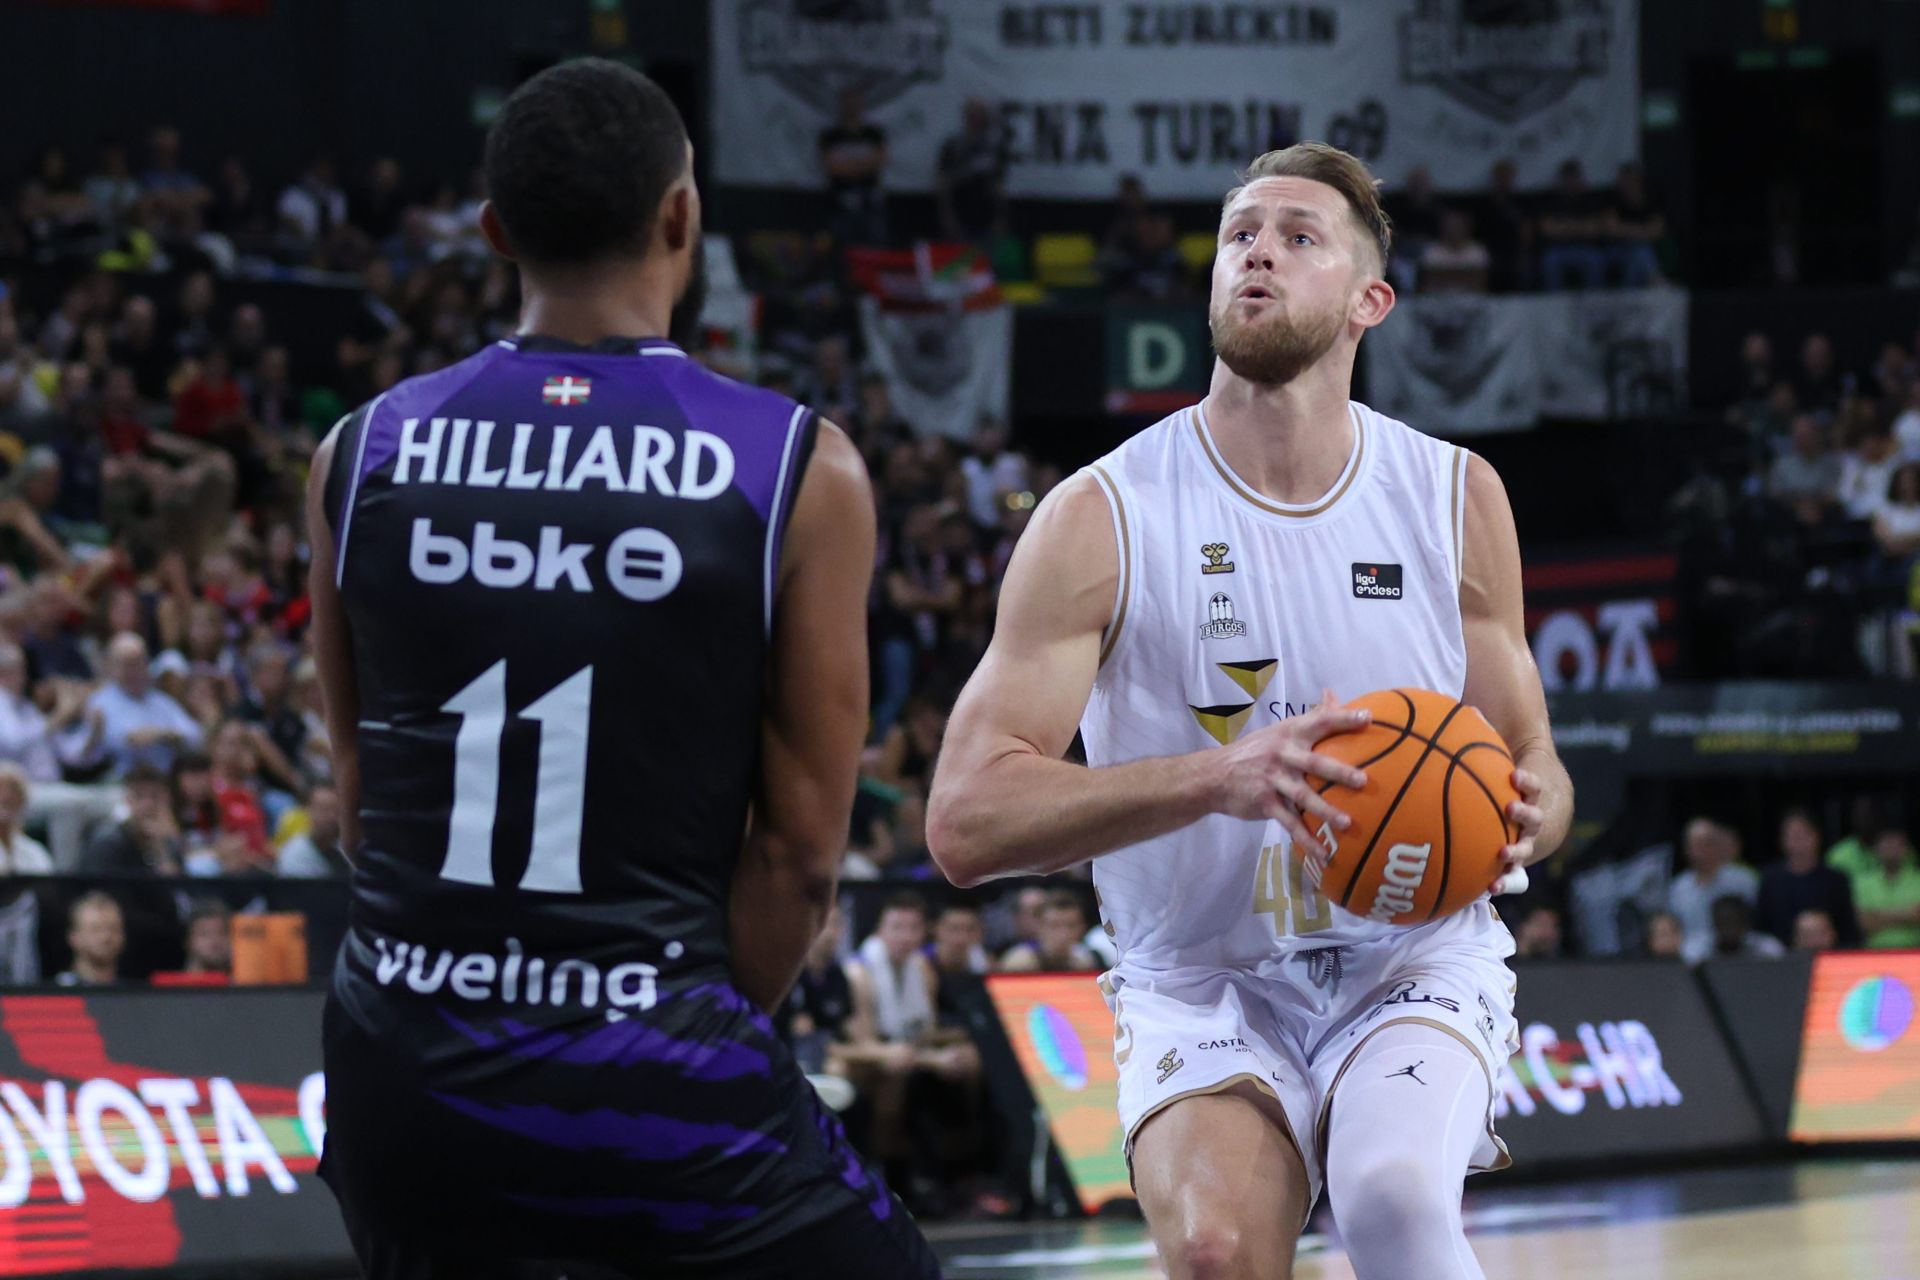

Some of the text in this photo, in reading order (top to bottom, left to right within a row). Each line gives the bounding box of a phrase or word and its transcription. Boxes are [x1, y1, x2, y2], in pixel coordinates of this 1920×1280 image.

[1128, 321, 1185, 388] D
[392, 417, 735, 500] HILLIARD
[409, 518, 595, 592] bbk
[1355, 572, 1376, 586] liga
[1356, 585, 1400, 596] endesa
[1205, 622, 1243, 636] BURGOS
[438, 658, 594, 893] 11
[375, 937, 660, 1023] vueling
